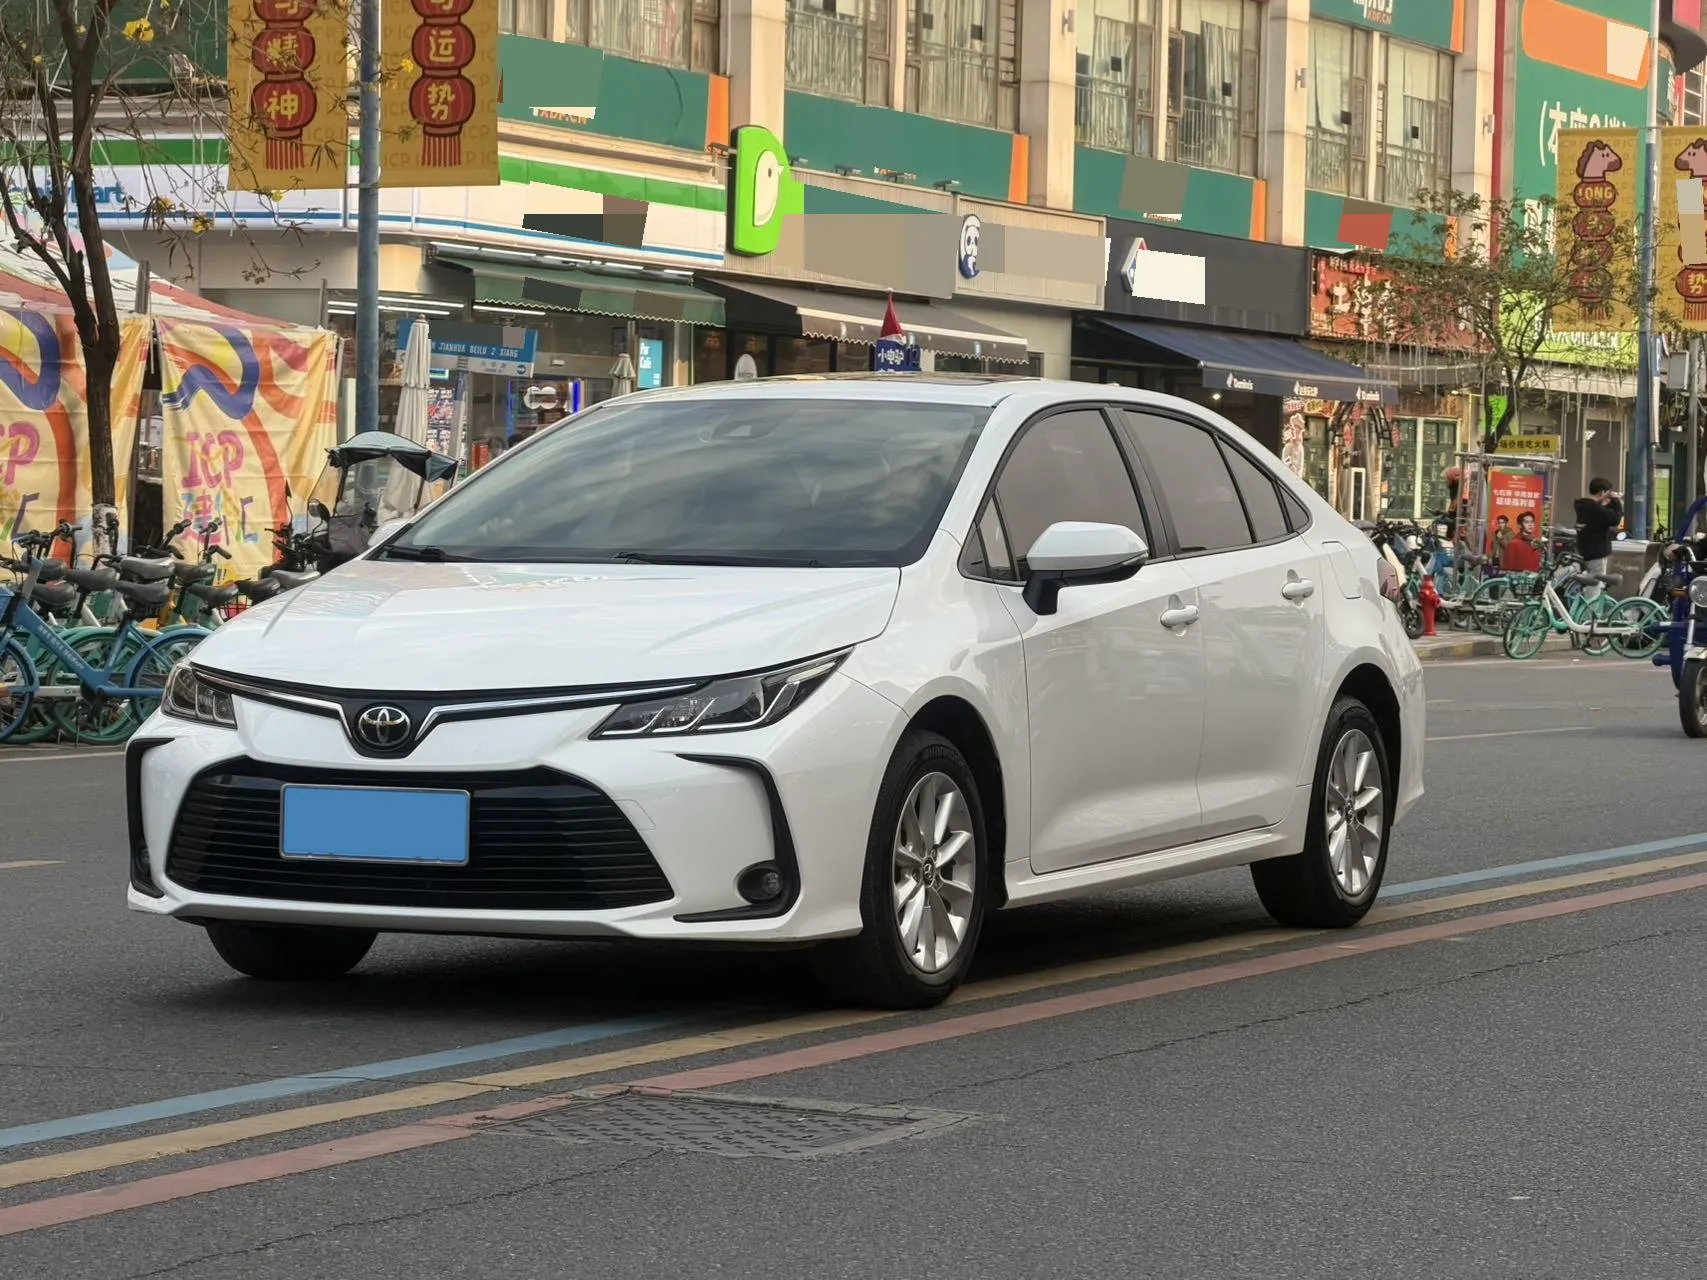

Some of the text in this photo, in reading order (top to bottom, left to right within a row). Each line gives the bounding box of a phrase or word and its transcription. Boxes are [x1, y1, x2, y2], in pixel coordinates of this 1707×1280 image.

[438, 342, 466, 353] JIANHUA
[469, 344, 487, 354] BEILU
[491, 347, 496, 356] 2
[500, 348, 518, 358] XIANG
[181, 430, 244, 488] ICP
